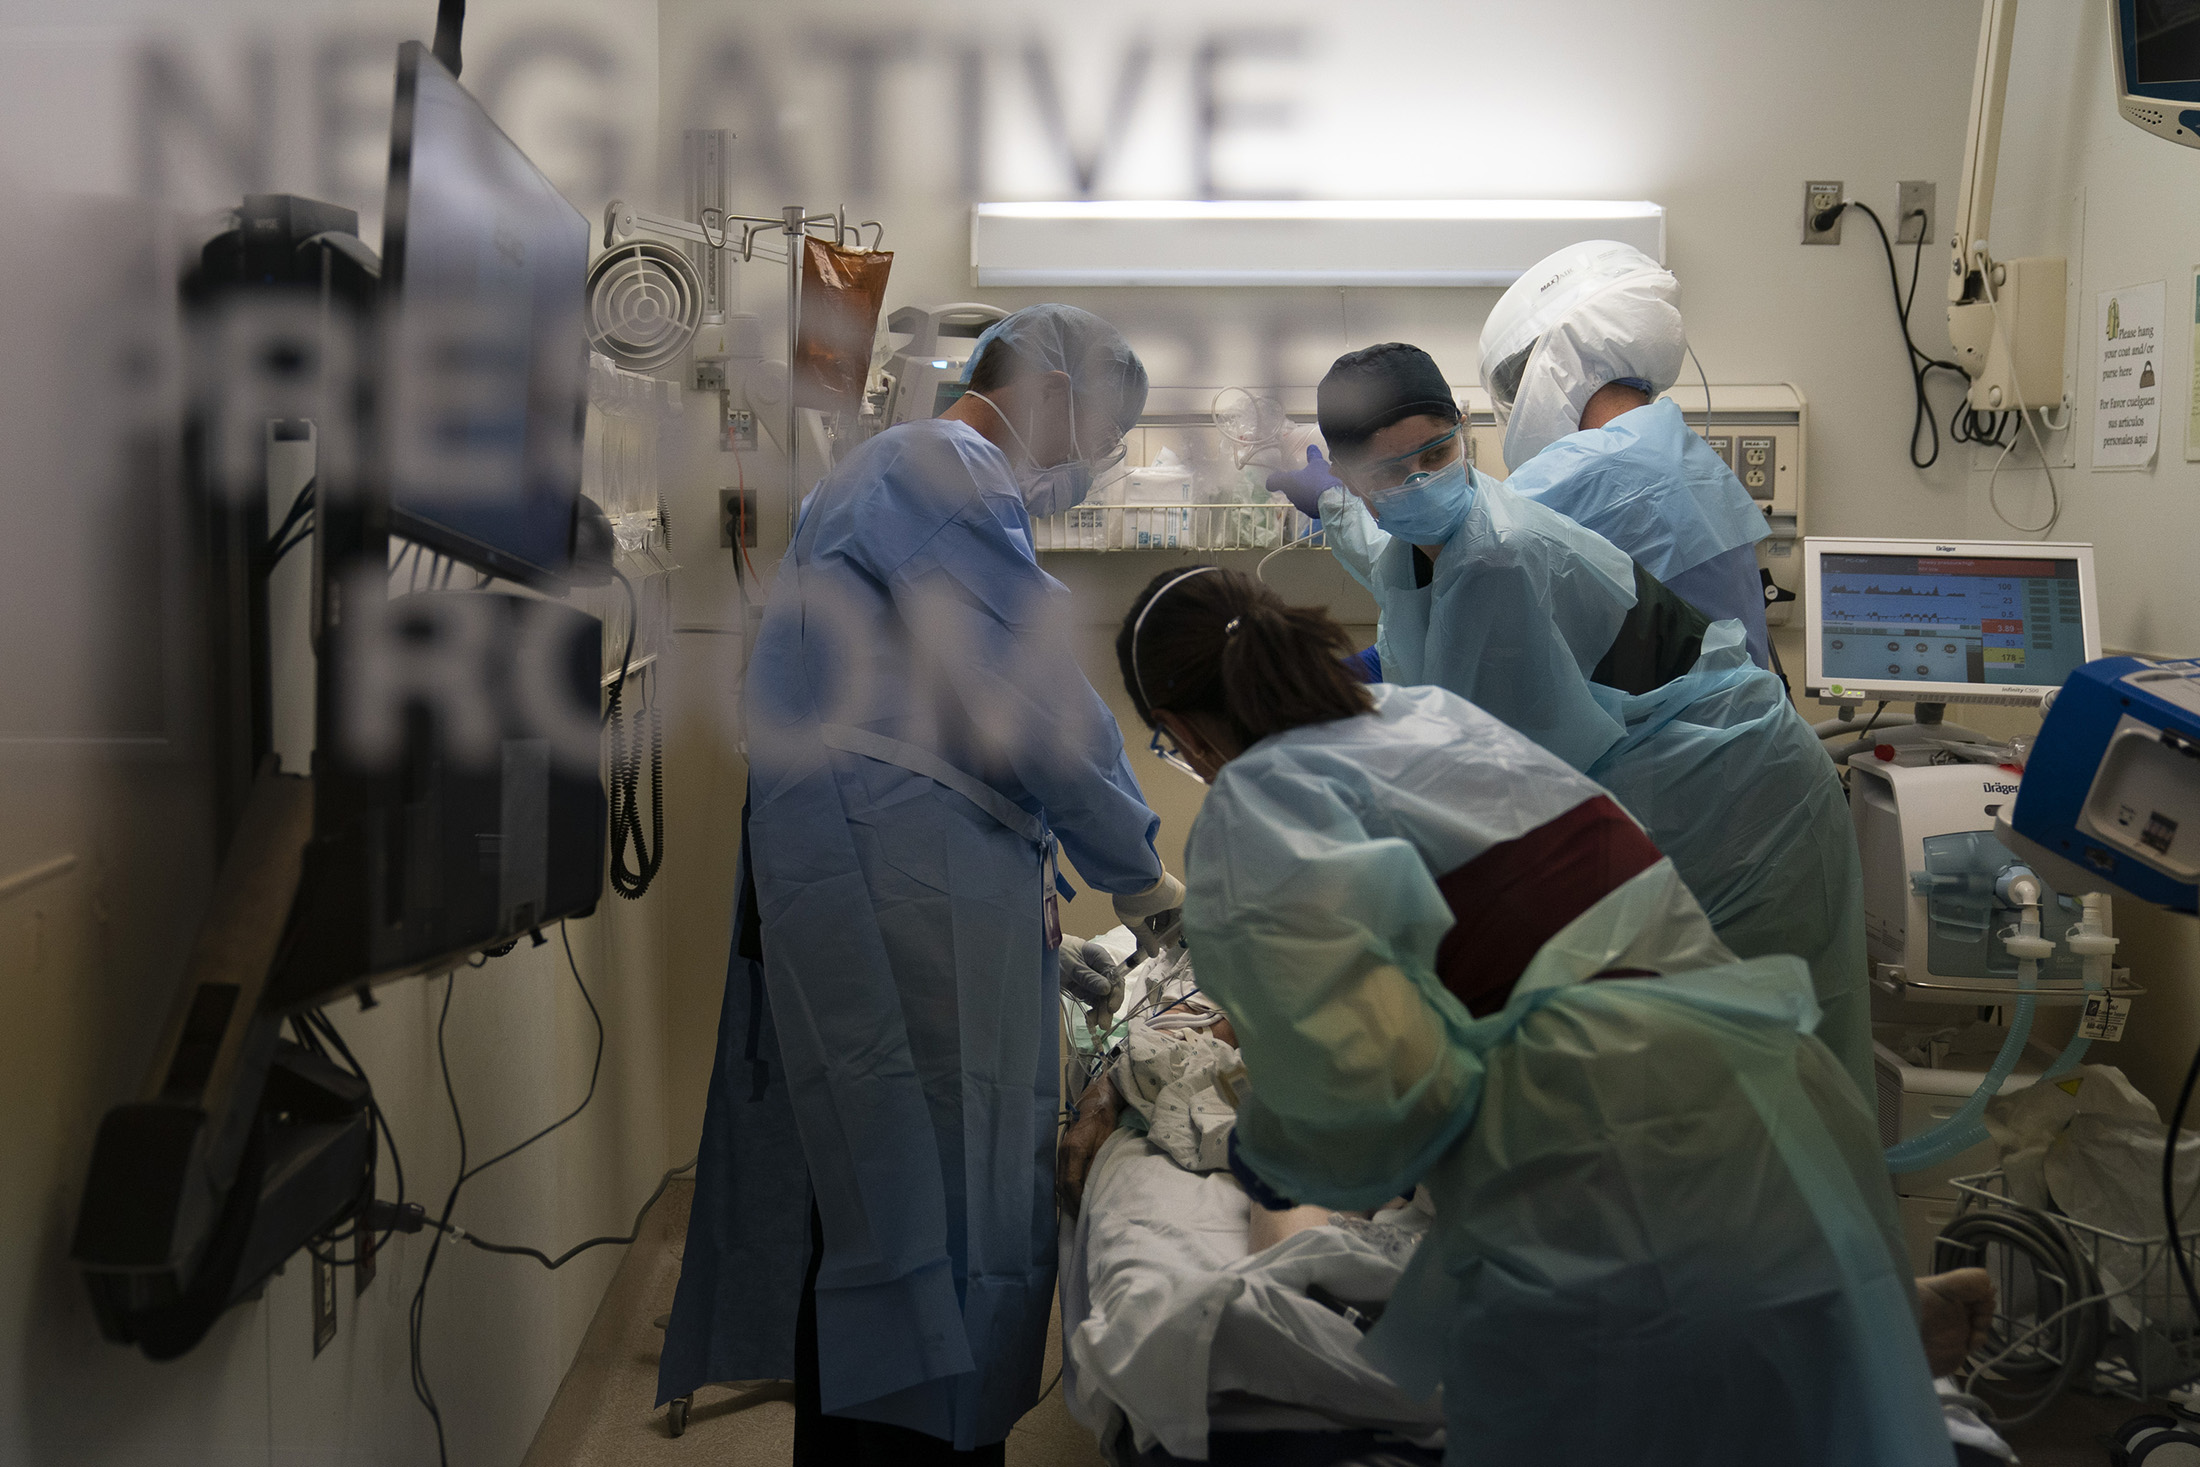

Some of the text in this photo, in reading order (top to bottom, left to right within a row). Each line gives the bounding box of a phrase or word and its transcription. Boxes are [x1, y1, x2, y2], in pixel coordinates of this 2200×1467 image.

[128, 27, 1325, 202] NEGATIVE
[2119, 326, 2154, 340] Please hang
[2104, 343, 2154, 362] your coat and/or
[2103, 366, 2132, 382] purse here
[2100, 399, 2110, 410] Por
[2110, 398, 2127, 409] Favor
[2108, 419, 2118, 428] sus
[2103, 434, 2133, 450] personales
[340, 568, 1080, 760] ROOM
[1982, 782, 2019, 794] Dräger
